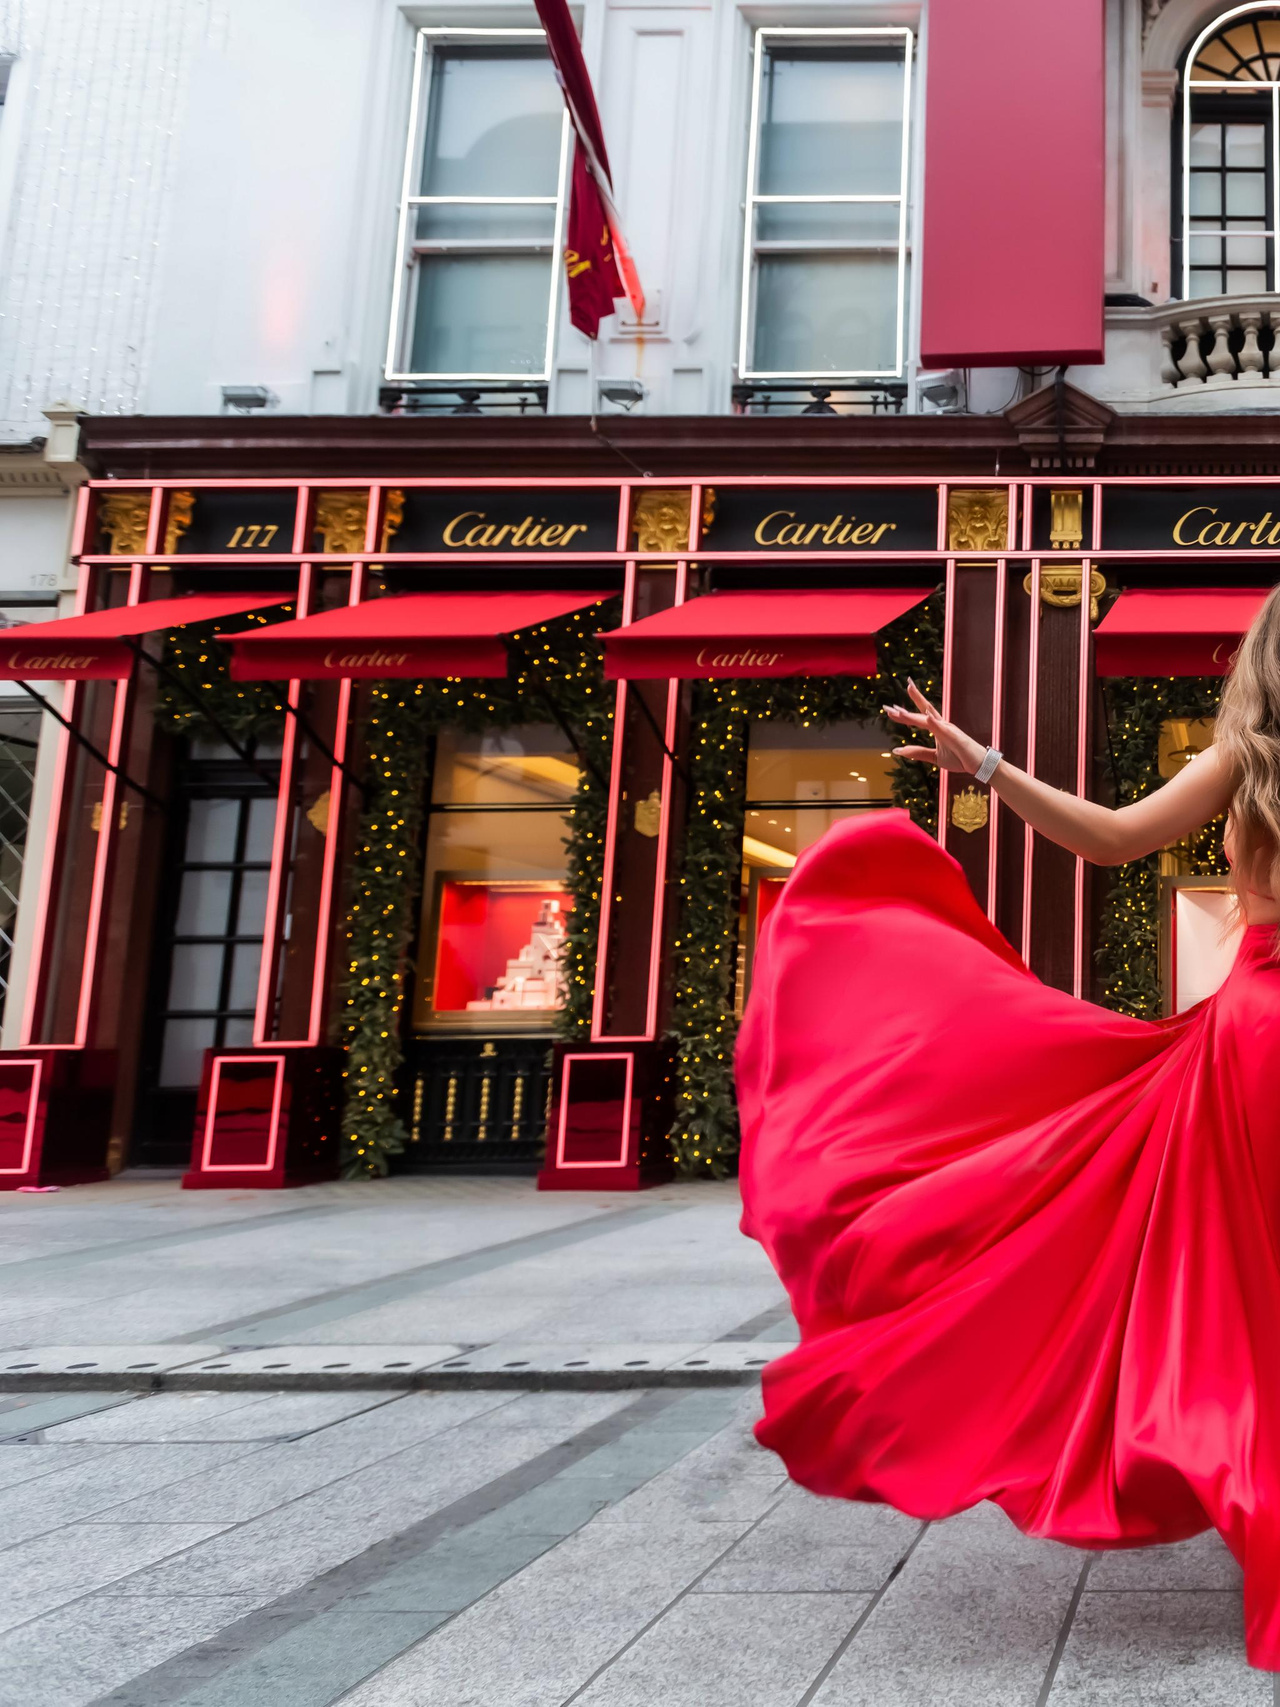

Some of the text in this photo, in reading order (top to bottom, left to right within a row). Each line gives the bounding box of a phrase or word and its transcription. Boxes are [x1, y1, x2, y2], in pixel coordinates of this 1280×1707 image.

[226, 524, 279, 548] 177
[442, 511, 588, 547] Cartier
[754, 511, 897, 545] Cartier
[30, 573, 58, 587] 178
[8, 650, 99, 670] Cartier
[324, 649, 412, 668] Cartier
[696, 647, 784, 667] Cartier
